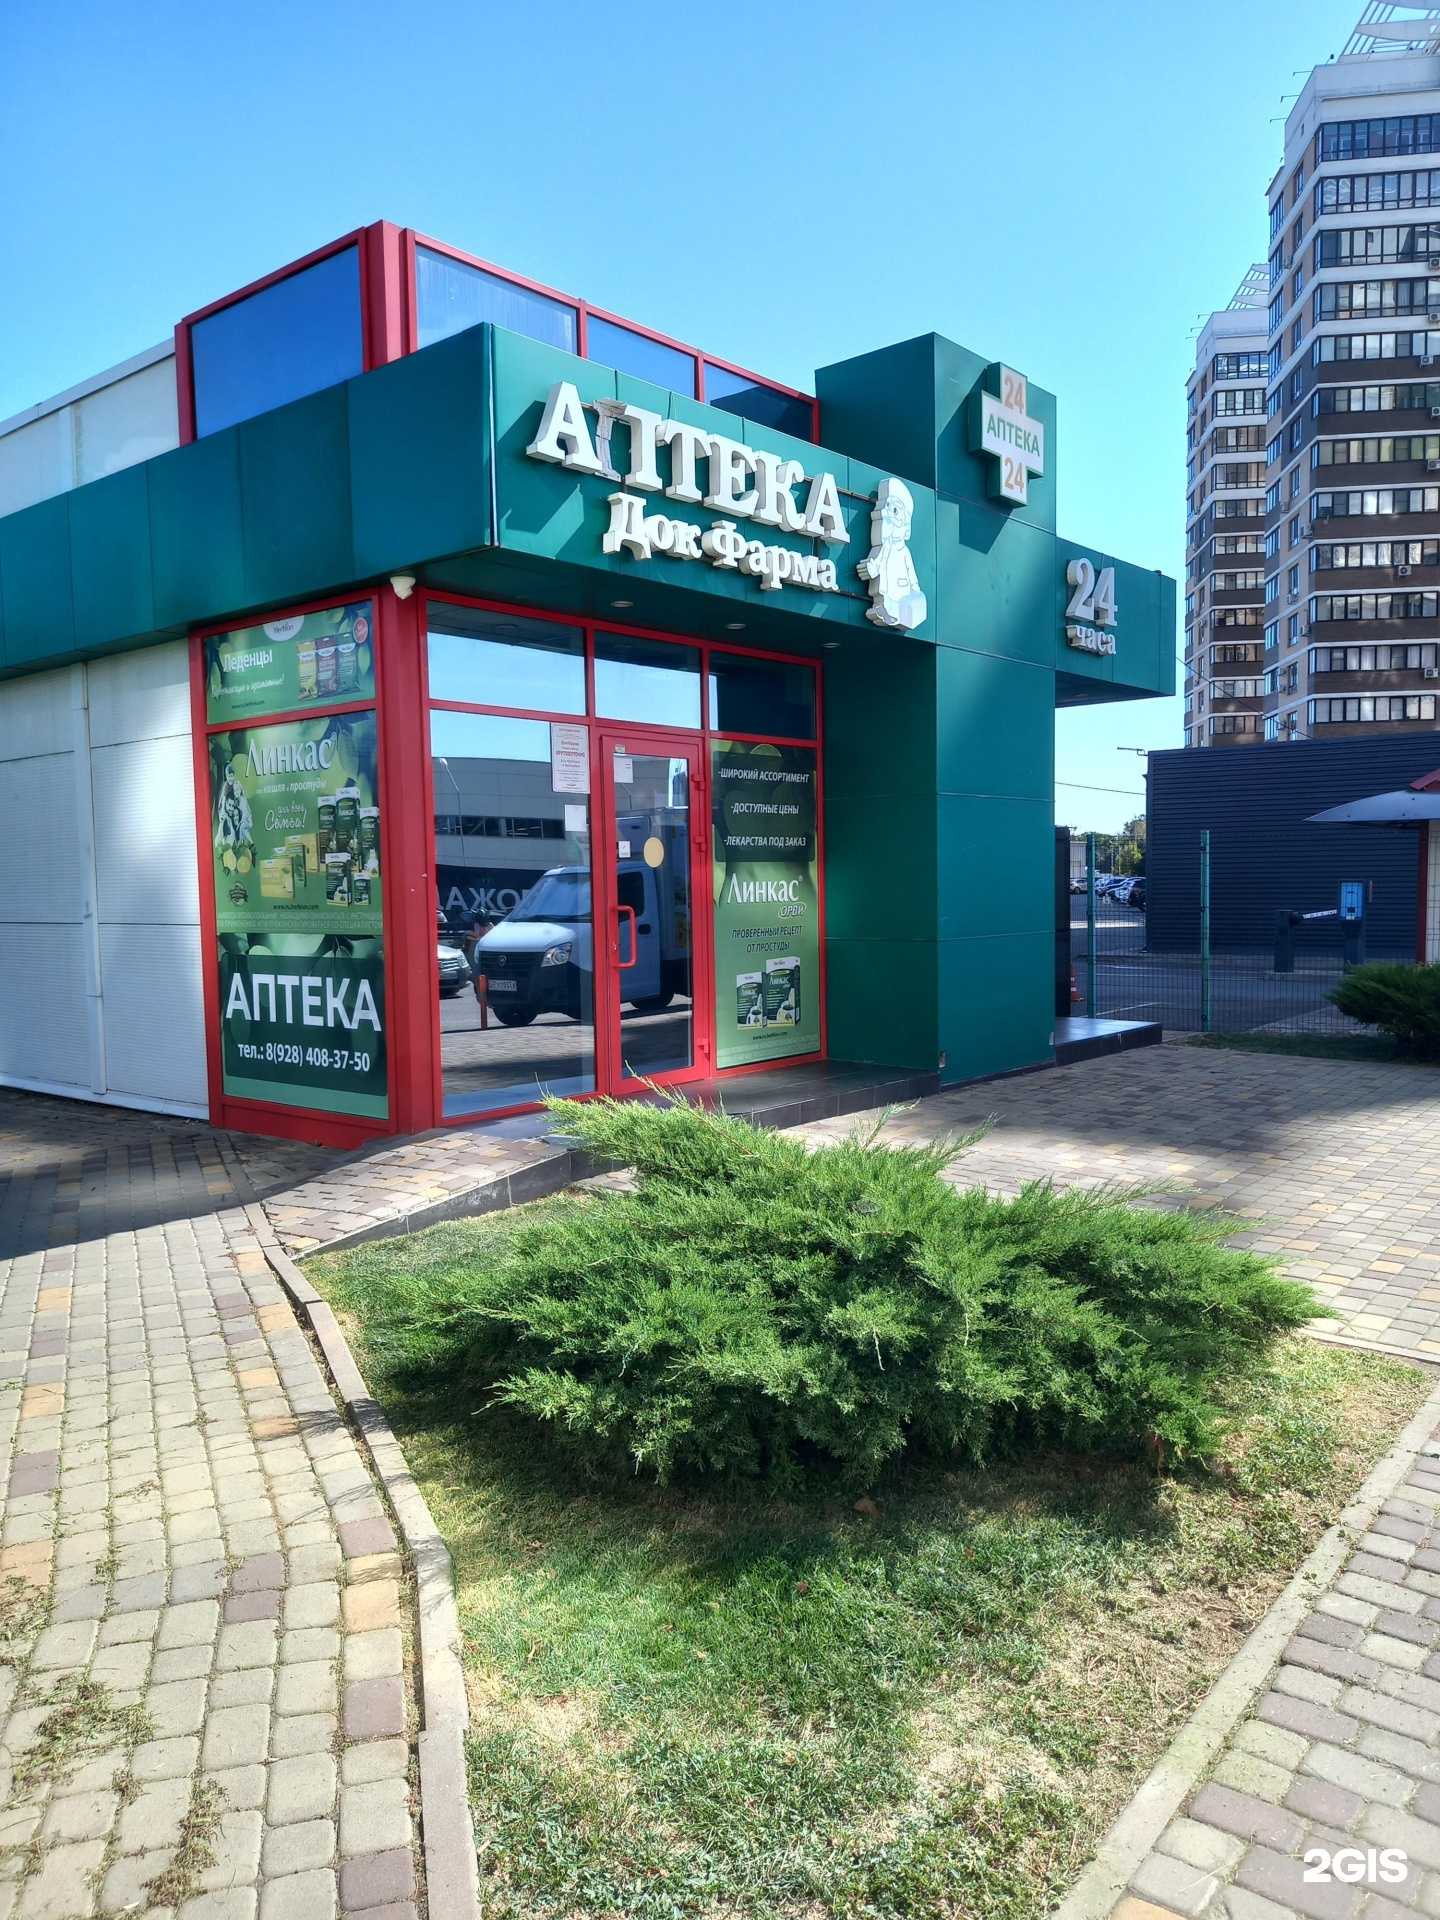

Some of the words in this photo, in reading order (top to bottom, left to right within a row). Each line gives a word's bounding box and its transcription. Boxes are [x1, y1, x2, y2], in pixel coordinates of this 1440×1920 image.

[1004, 374, 1025, 414] 24
[986, 412, 1041, 457] АПТЕКА
[526, 381, 851, 544] АПТЕКА
[1004, 456, 1025, 494] 24
[603, 492, 702, 560] Док
[702, 520, 841, 591] Фарма
[1065, 557, 1118, 627] 24
[1066, 624, 1117, 656] часа
[223, 649, 273, 673] Леденцы
[244, 737, 333, 777] Линкас
[759, 770, 810, 783] АССОРТИМЕНТ
[779, 804, 799, 816] ЦЕНЫ
[768, 836, 784, 848] ПОД
[785, 837, 806, 847] ЗАКАЗ
[727, 873, 800, 904] Линкас
[732, 926, 779, 939] ПРОВЕРЕННЫЙ
[779, 925, 802, 937] РЕЦЕПТ
[746, 943, 755, 953] ОТ
[755, 941, 790, 952] ПРОСТУДЫ
[225, 972, 382, 1032] АПТЕКА
[238, 1043, 264, 1060] тел.:
[266, 1043, 304, 1067] 8(928)
[306, 1047, 371, 1072] 408-37-50
